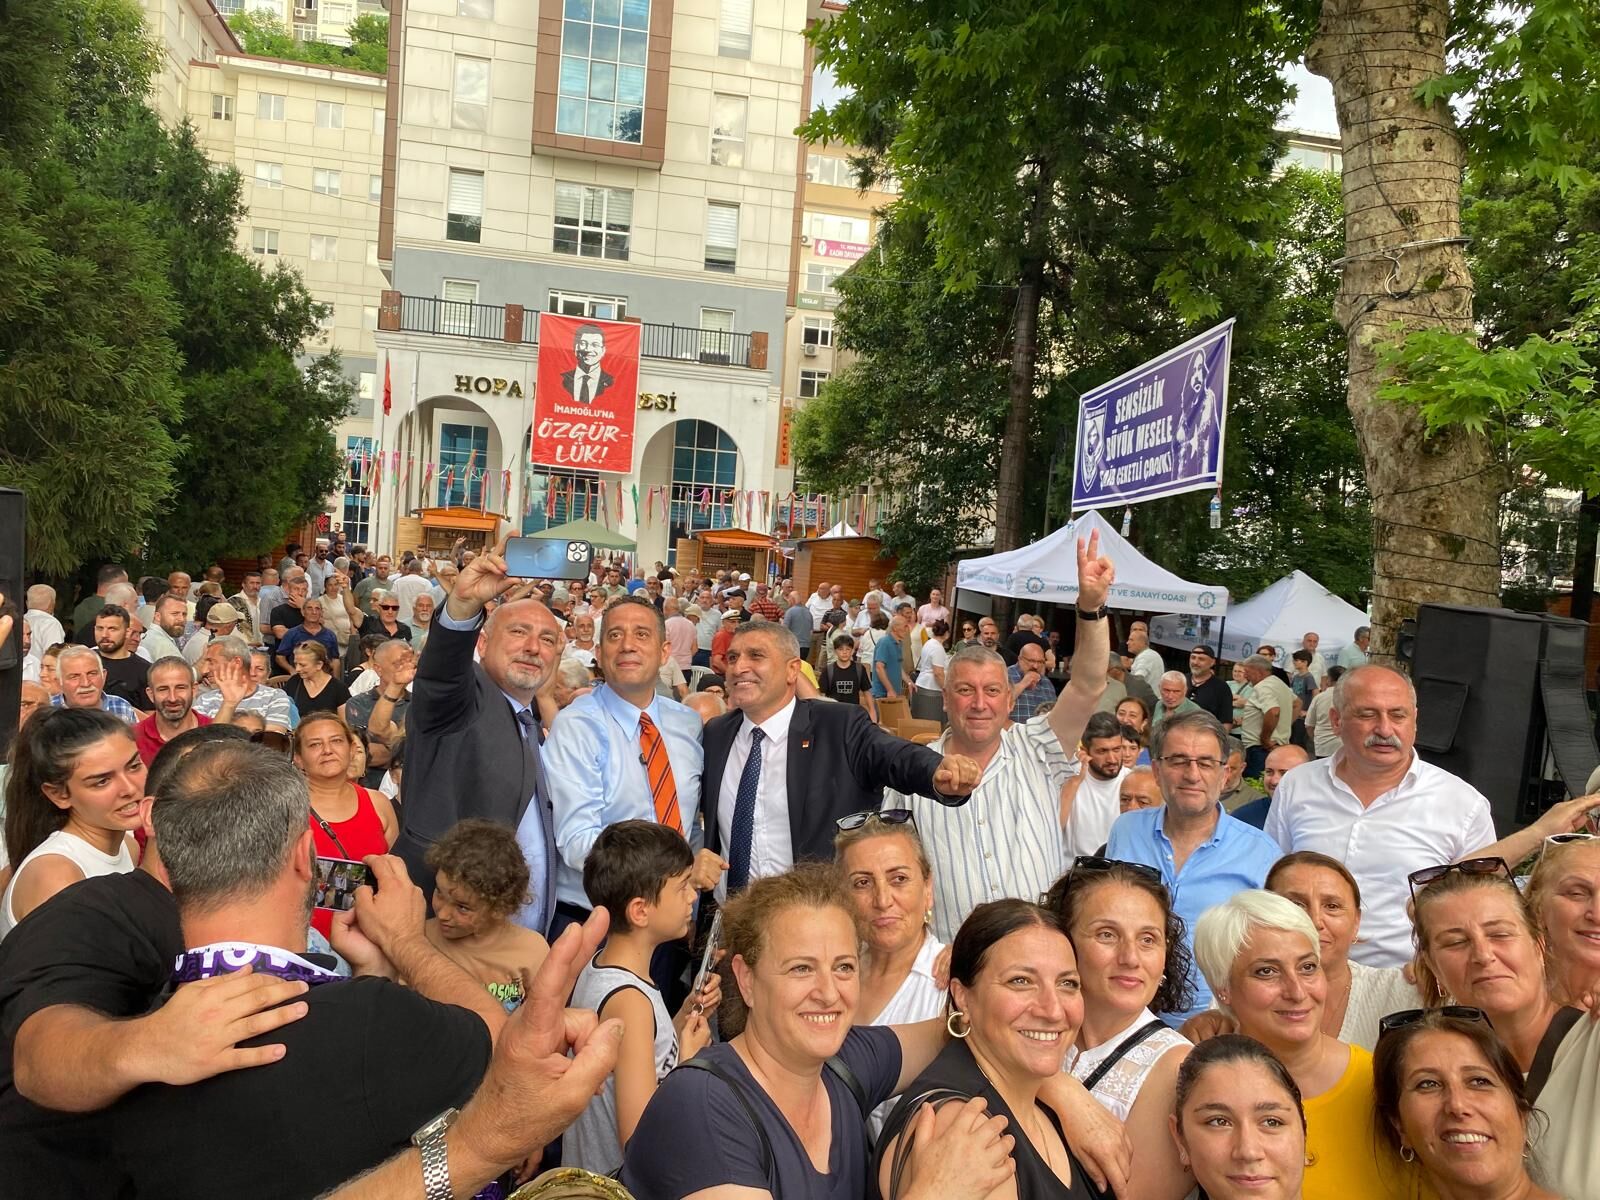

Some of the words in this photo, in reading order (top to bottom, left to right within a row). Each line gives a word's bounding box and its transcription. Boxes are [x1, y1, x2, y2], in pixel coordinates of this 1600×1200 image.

[454, 374, 523, 398] HOPA
[554, 402, 615, 419] İMAMOĞLU'NA
[1115, 375, 1166, 425] SENSİZLİK
[1106, 424, 1135, 462] BÜYÜK
[1135, 415, 1173, 453] MESELE
[555, 441, 609, 464] LÜK!
[1116, 456, 1143, 486] CEKETLİ
[1130, 590, 1160, 599] SANAYİ
[1161, 594, 1187, 603] ODASI
